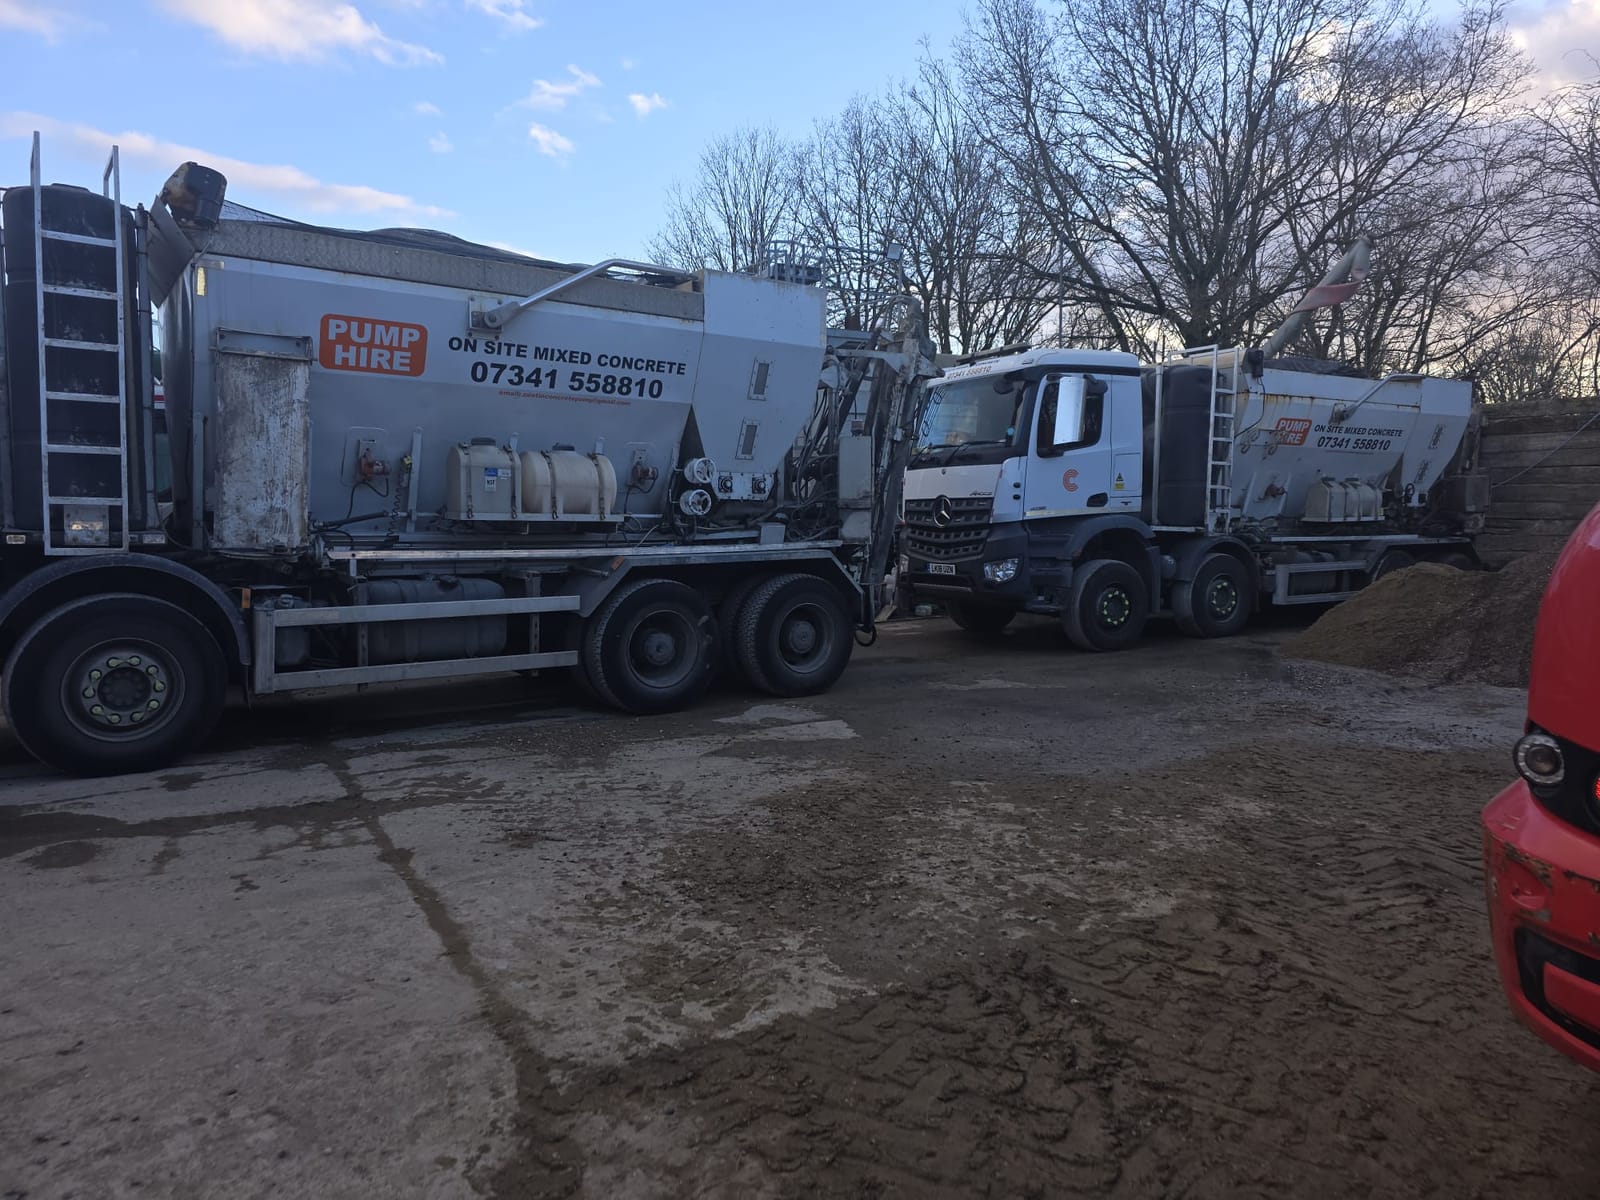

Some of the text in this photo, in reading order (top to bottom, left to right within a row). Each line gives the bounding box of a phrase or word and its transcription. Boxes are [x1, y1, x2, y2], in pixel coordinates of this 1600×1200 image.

[328, 318, 420, 348] PUMP
[334, 344, 411, 372] HIRE
[448, 336, 687, 375] ON SITE MIXED CONCRETE
[470, 361, 664, 399] 07341 558810
[1279, 420, 1310, 432] PUMP
[1314, 424, 1404, 438] ON SITE MIXED CONCRETE
[1317, 436, 1391, 451] 07341 558810
